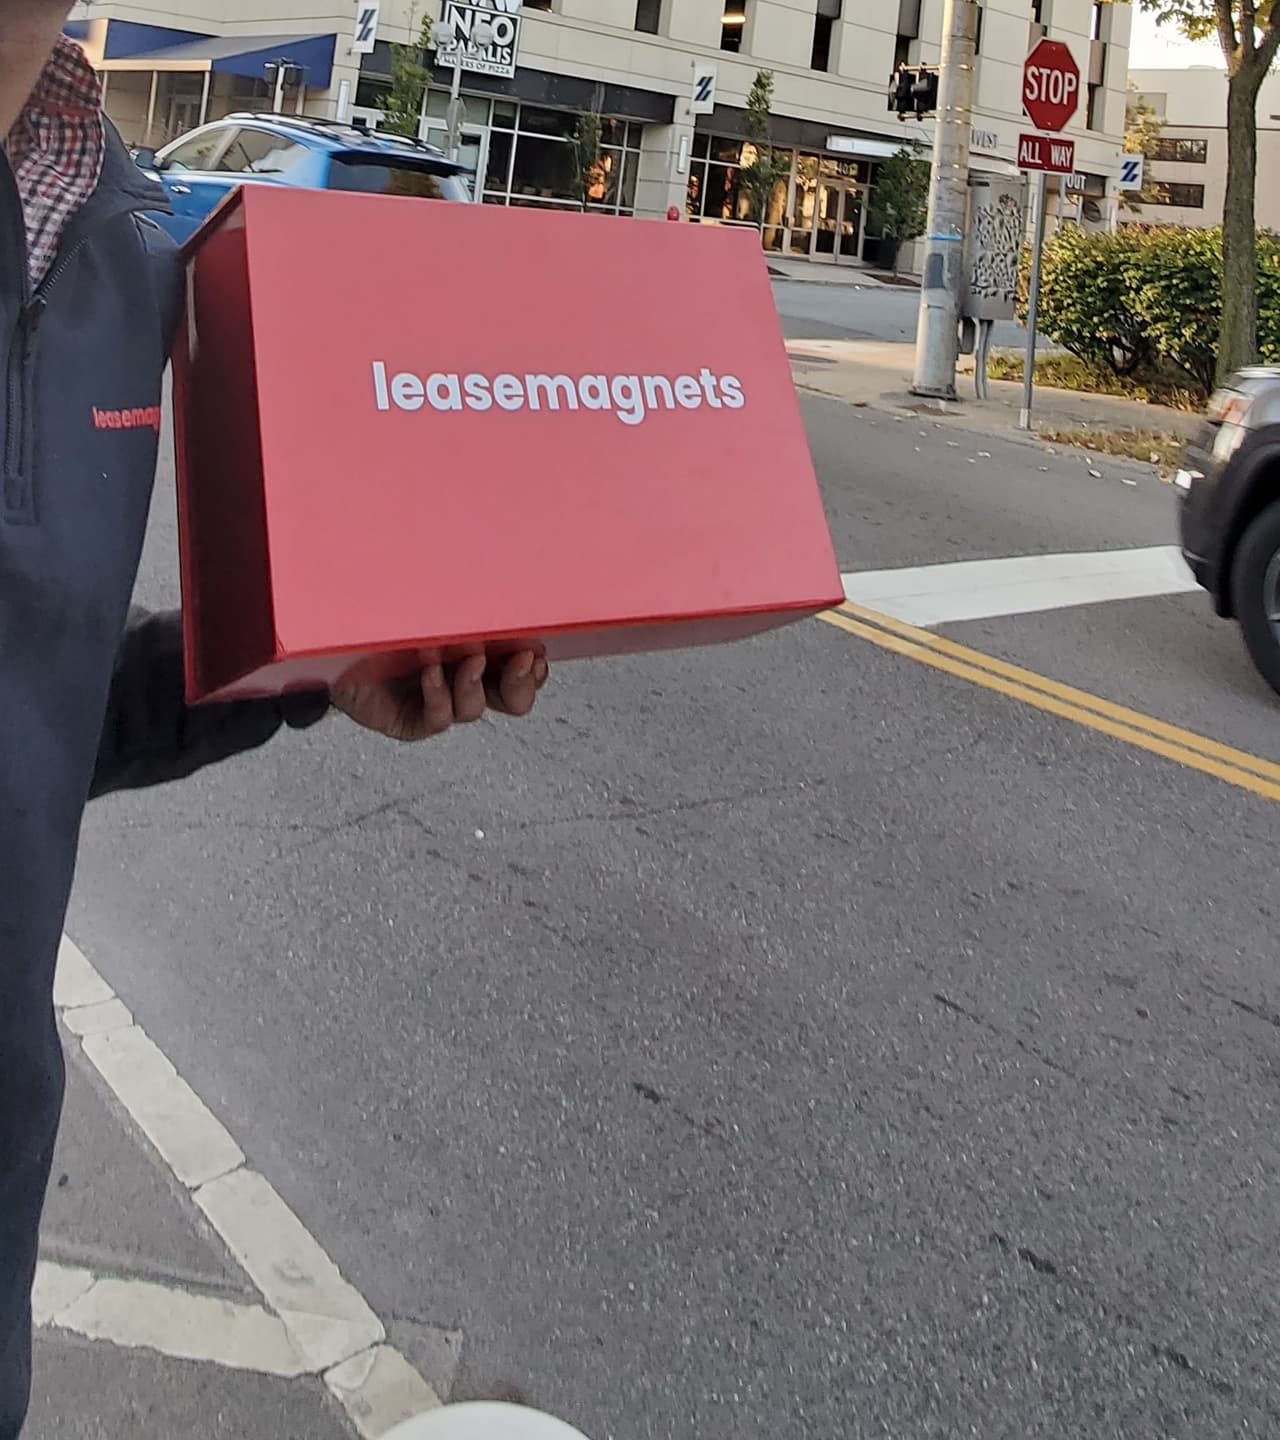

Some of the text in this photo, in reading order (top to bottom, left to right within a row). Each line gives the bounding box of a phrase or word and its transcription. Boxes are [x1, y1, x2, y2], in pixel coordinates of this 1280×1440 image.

[1024, 65, 1077, 106] STOP
[1020, 140, 1073, 168] ALL WAY
[371, 360, 747, 426] leasemagnets
